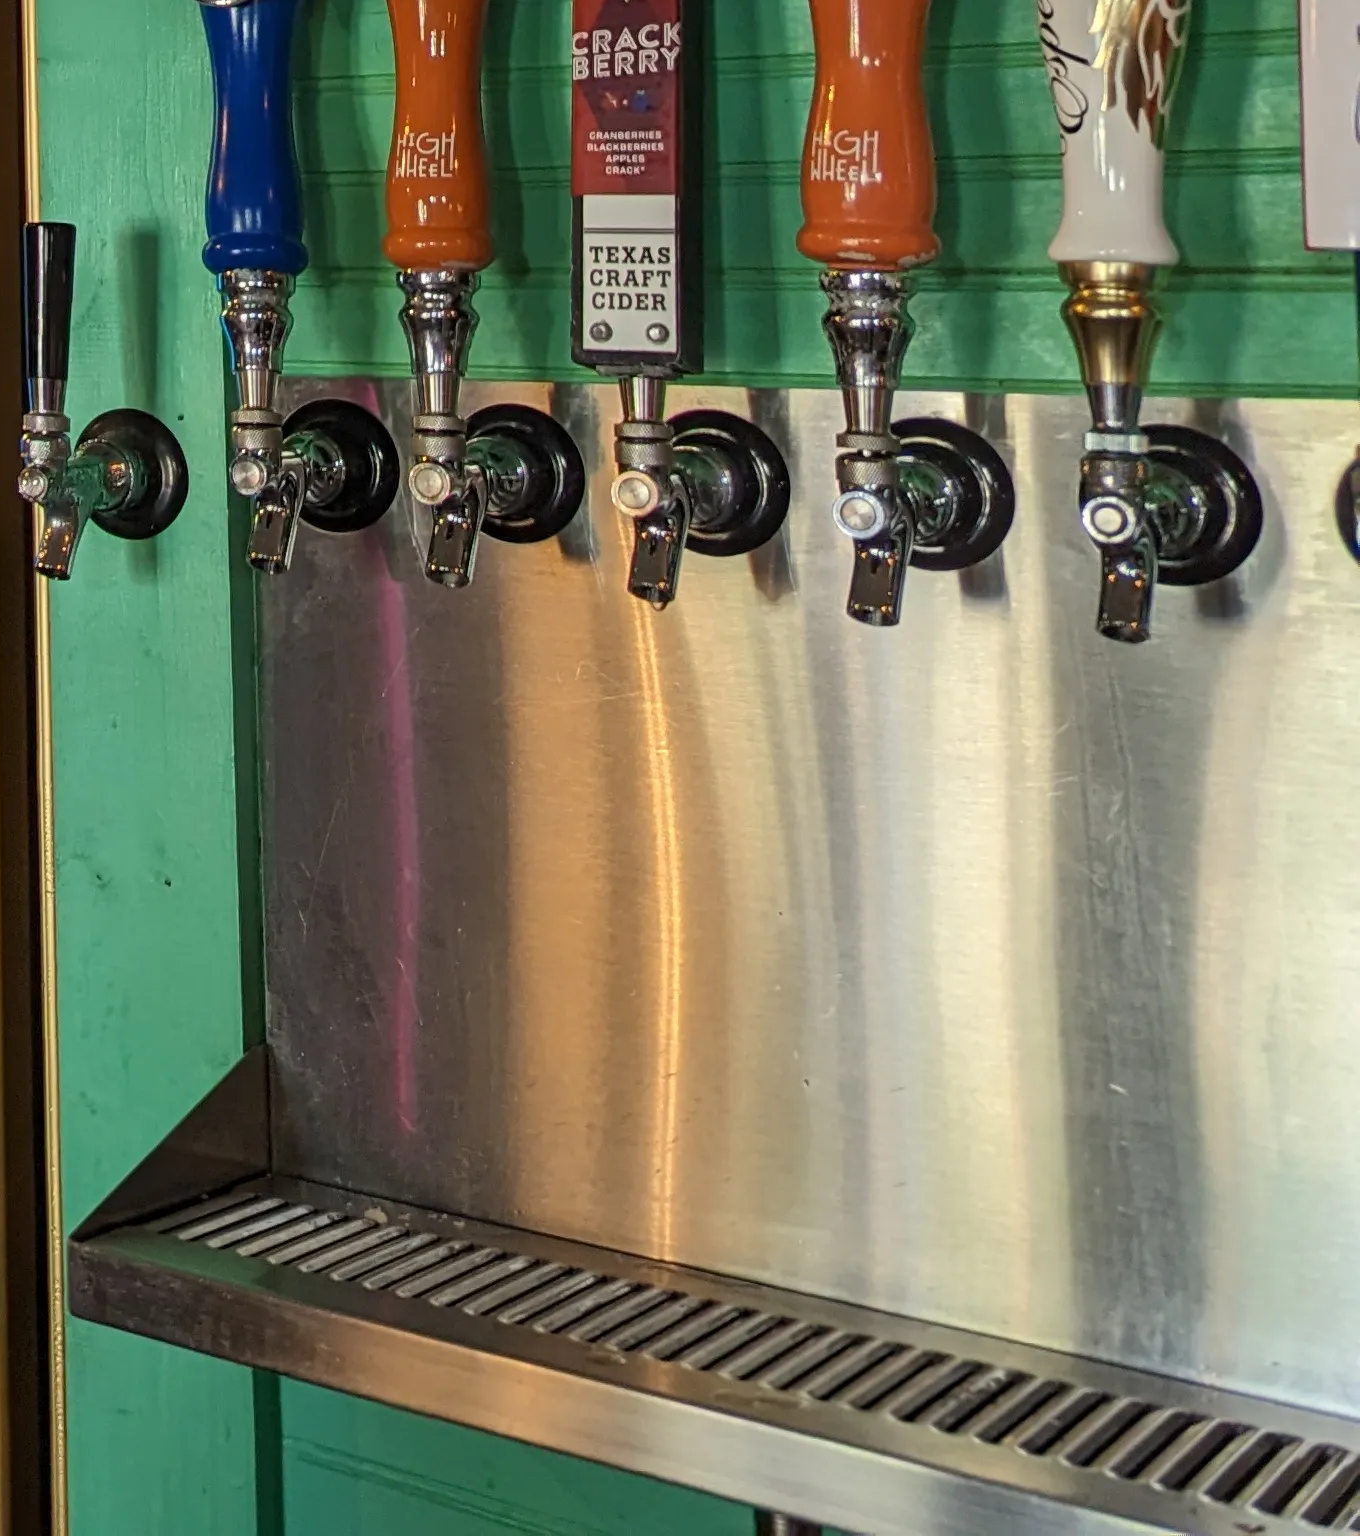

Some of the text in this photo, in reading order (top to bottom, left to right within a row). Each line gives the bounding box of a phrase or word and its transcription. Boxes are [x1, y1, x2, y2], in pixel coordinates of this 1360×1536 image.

[572, 21, 682, 56] CRACK
[572, 47, 680, 80] BERRY
[589, 130, 662, 140] CRANBERRIES
[396, 131, 456, 169] HIGH
[587, 142, 664, 152] BLACKBERRIES
[395, 151, 454, 178] WHEEL
[605, 153, 645, 164] APPLES
[589, 245, 671, 266] TEXAS
[589, 267, 672, 289] CRAFT
[591, 291, 667, 312] CIDER
